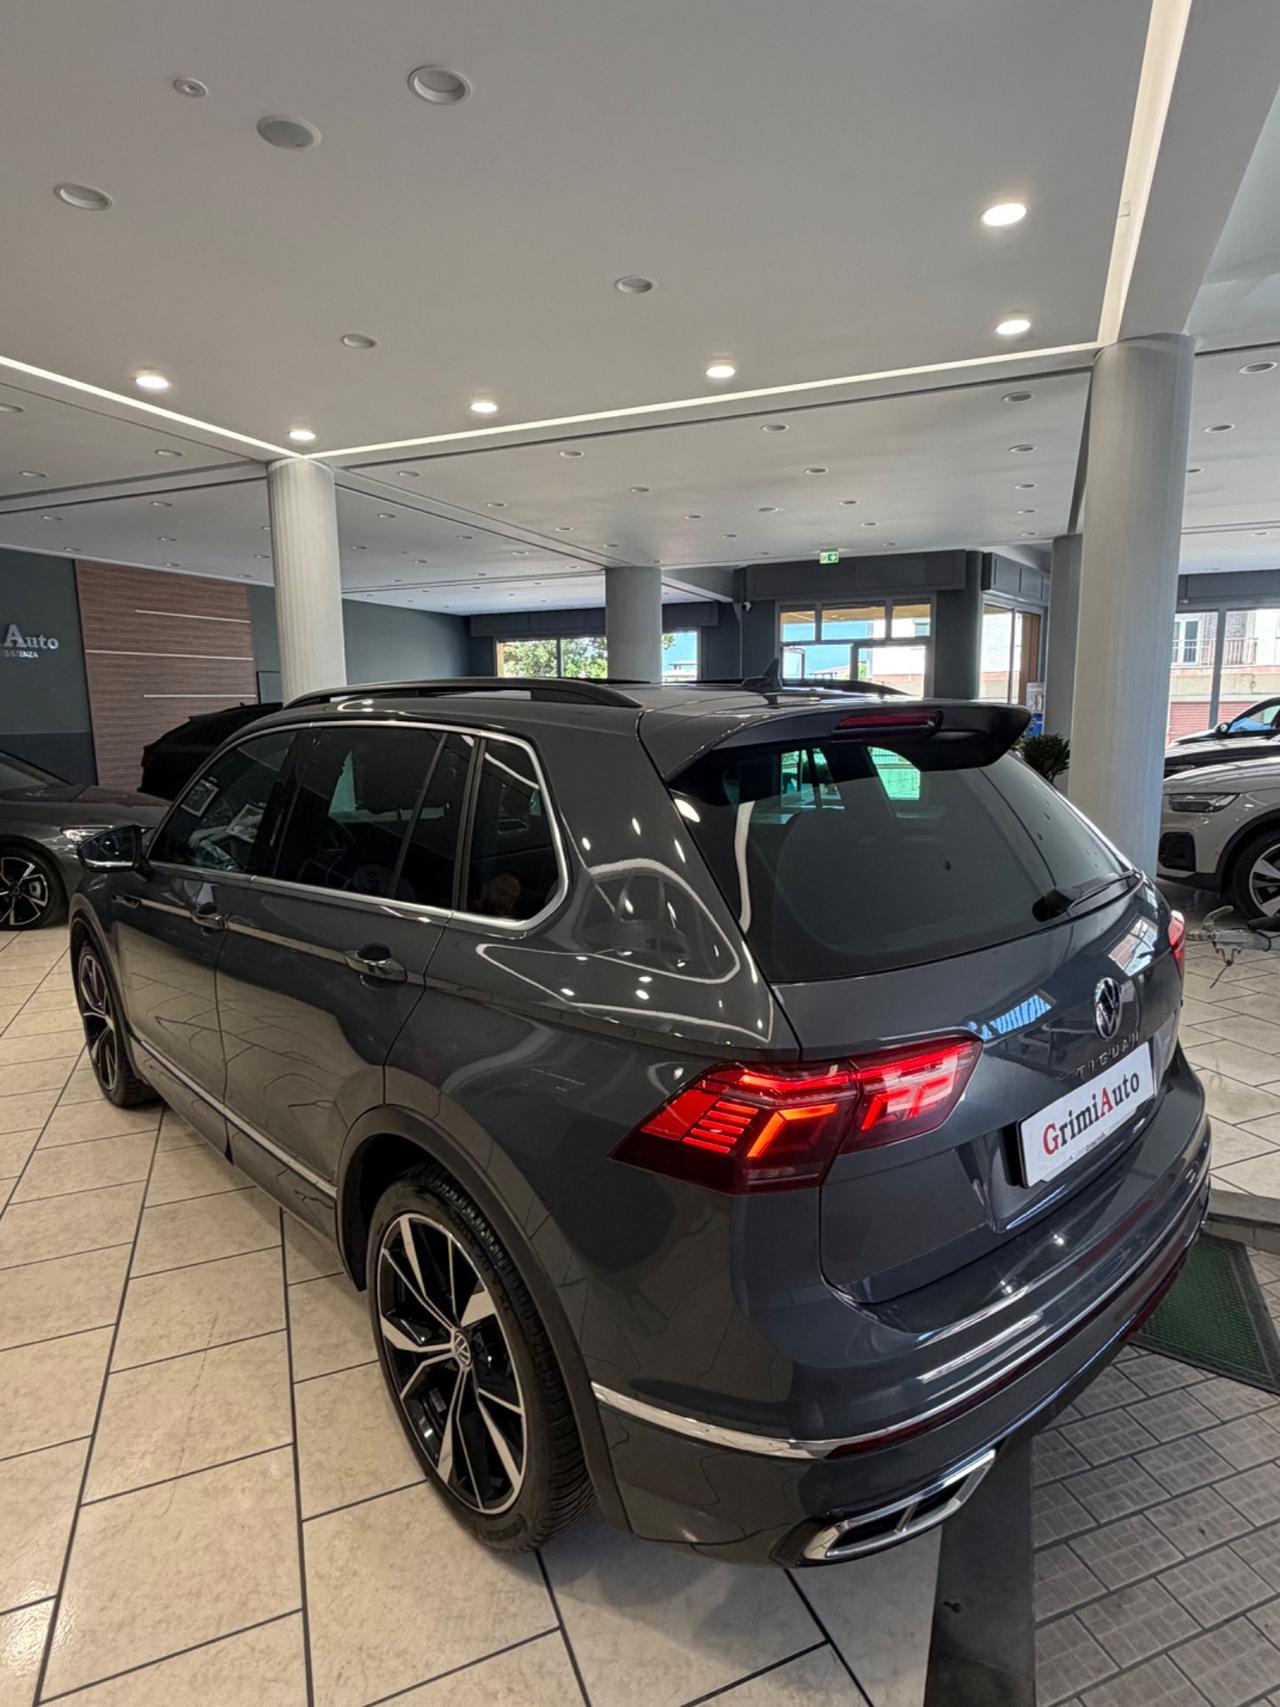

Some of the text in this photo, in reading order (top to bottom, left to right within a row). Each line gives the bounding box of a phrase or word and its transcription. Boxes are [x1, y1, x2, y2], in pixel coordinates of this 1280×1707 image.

[4, 624, 59, 649] Auto
[1076, 1031, 1139, 1080] TIGUAN
[1042, 1072, 1140, 1155] GrimiAuto
